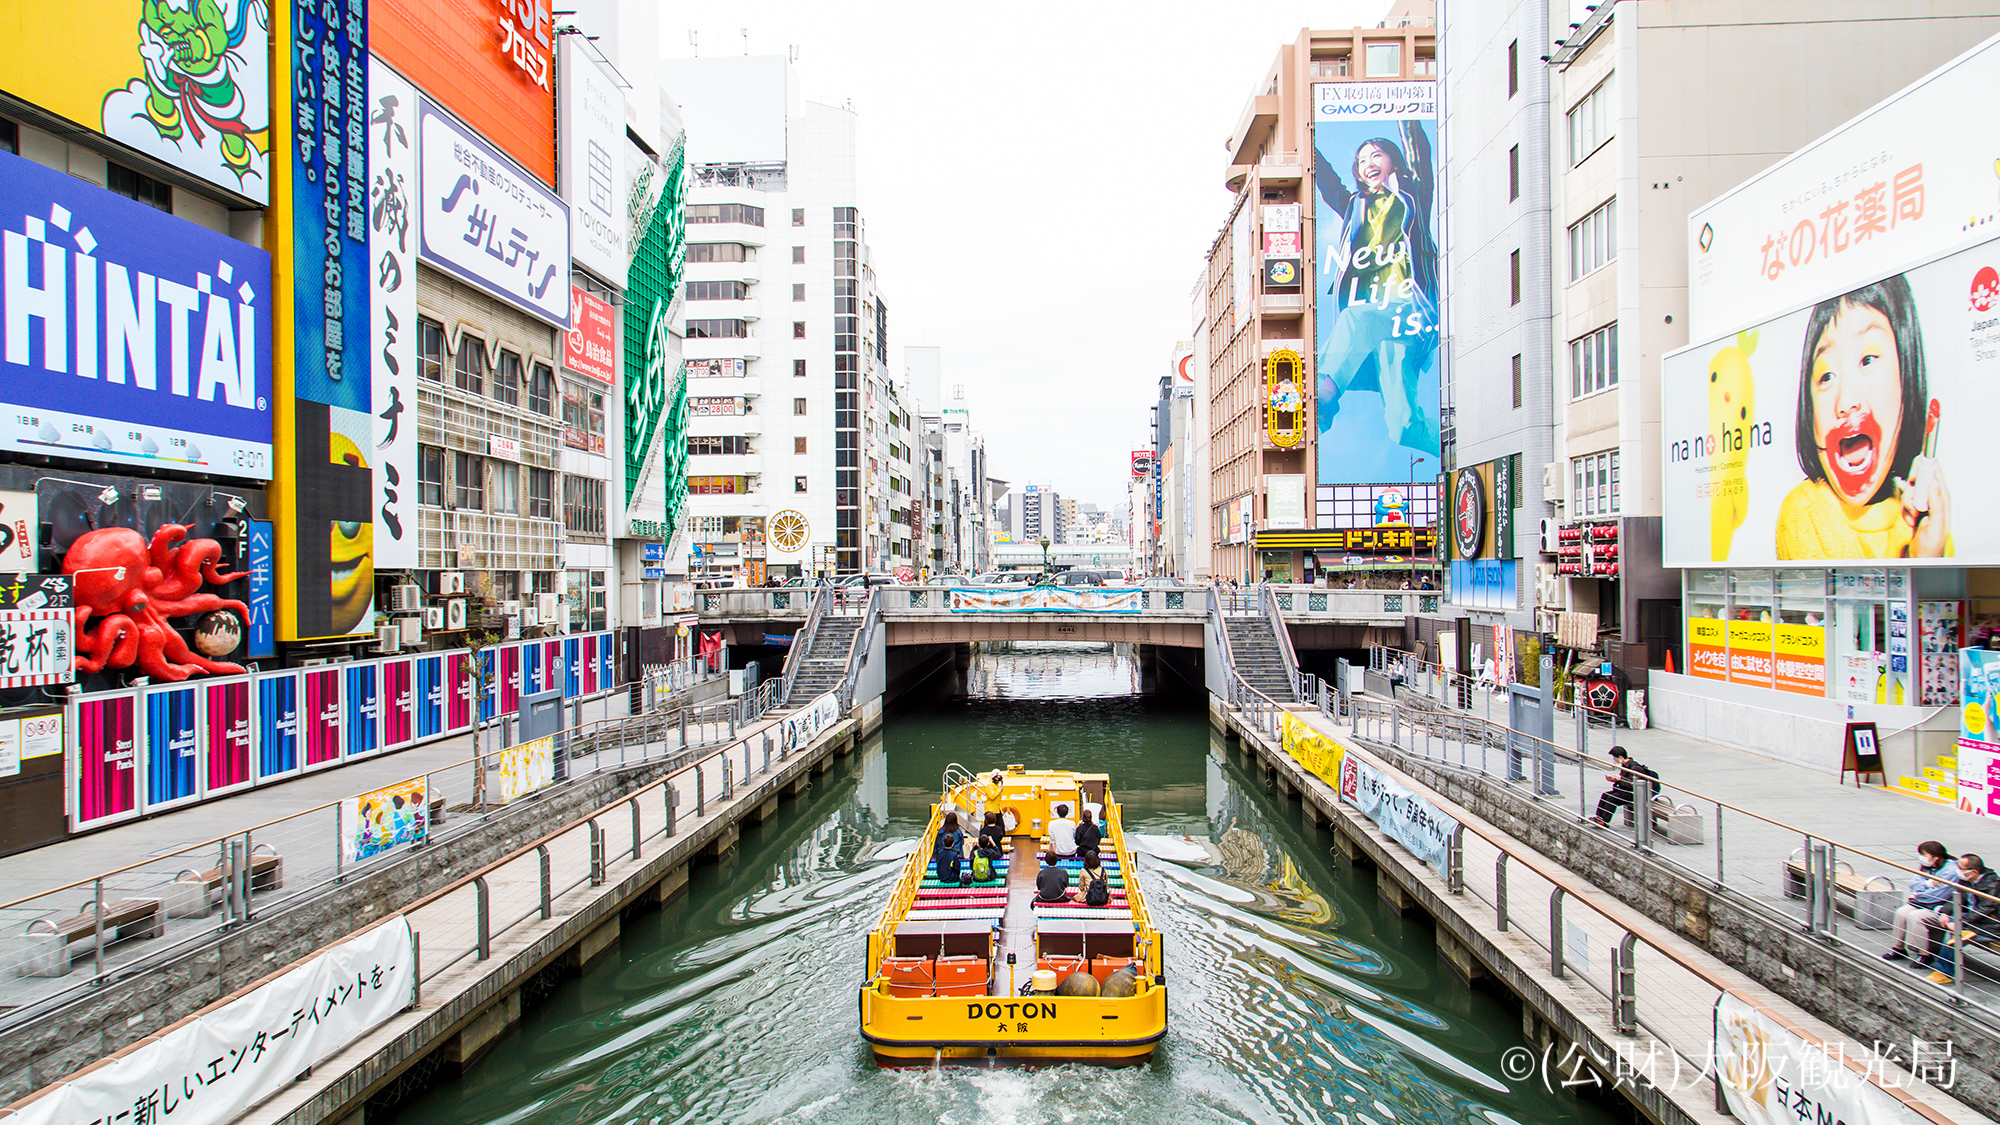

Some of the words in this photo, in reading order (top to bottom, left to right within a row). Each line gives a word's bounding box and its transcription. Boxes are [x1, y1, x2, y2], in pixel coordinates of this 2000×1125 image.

[500, 16, 549, 93] プロミス
[453, 141, 553, 219] 総合不動産のプロデューサー
[1761, 163, 1925, 282] なの花薬局
[463, 203, 540, 277] サムティ
[1323, 240, 1405, 275] New
[1348, 276, 1414, 311] Life
[1975, 349, 1997, 363] Shop
[17, 415, 39, 427] 18時
[72, 423, 94, 435] 24時
[128, 431, 142, 442] 6時
[170, 437, 187, 448] 12時
[1672, 440, 1689, 463] na
[1722, 422, 1743, 453] ha
[1749, 421, 1772, 448] na
[1723, 486, 1744, 496] SHOP
[238, 520, 247, 558] 2F
[460, 544, 475, 560] BAR
[252, 532, 269, 644] ペンギンバー
[50, 594, 70, 607] 2F
[1730, 631, 1771, 642] オーガニックコスメ
[1781, 634, 1818, 647] ブランドコスメ
[55, 629, 67, 661] 検索
[1731, 654, 1771, 674] 由に試せる
[1776, 659, 1824, 682] 体験型空間
[537, 703, 555, 712] information
[967, 1003, 1056, 1019] DOTON
[997, 1022, 1028, 1033] 大阪
[1775, 1075, 1846, 1125] 日本M
